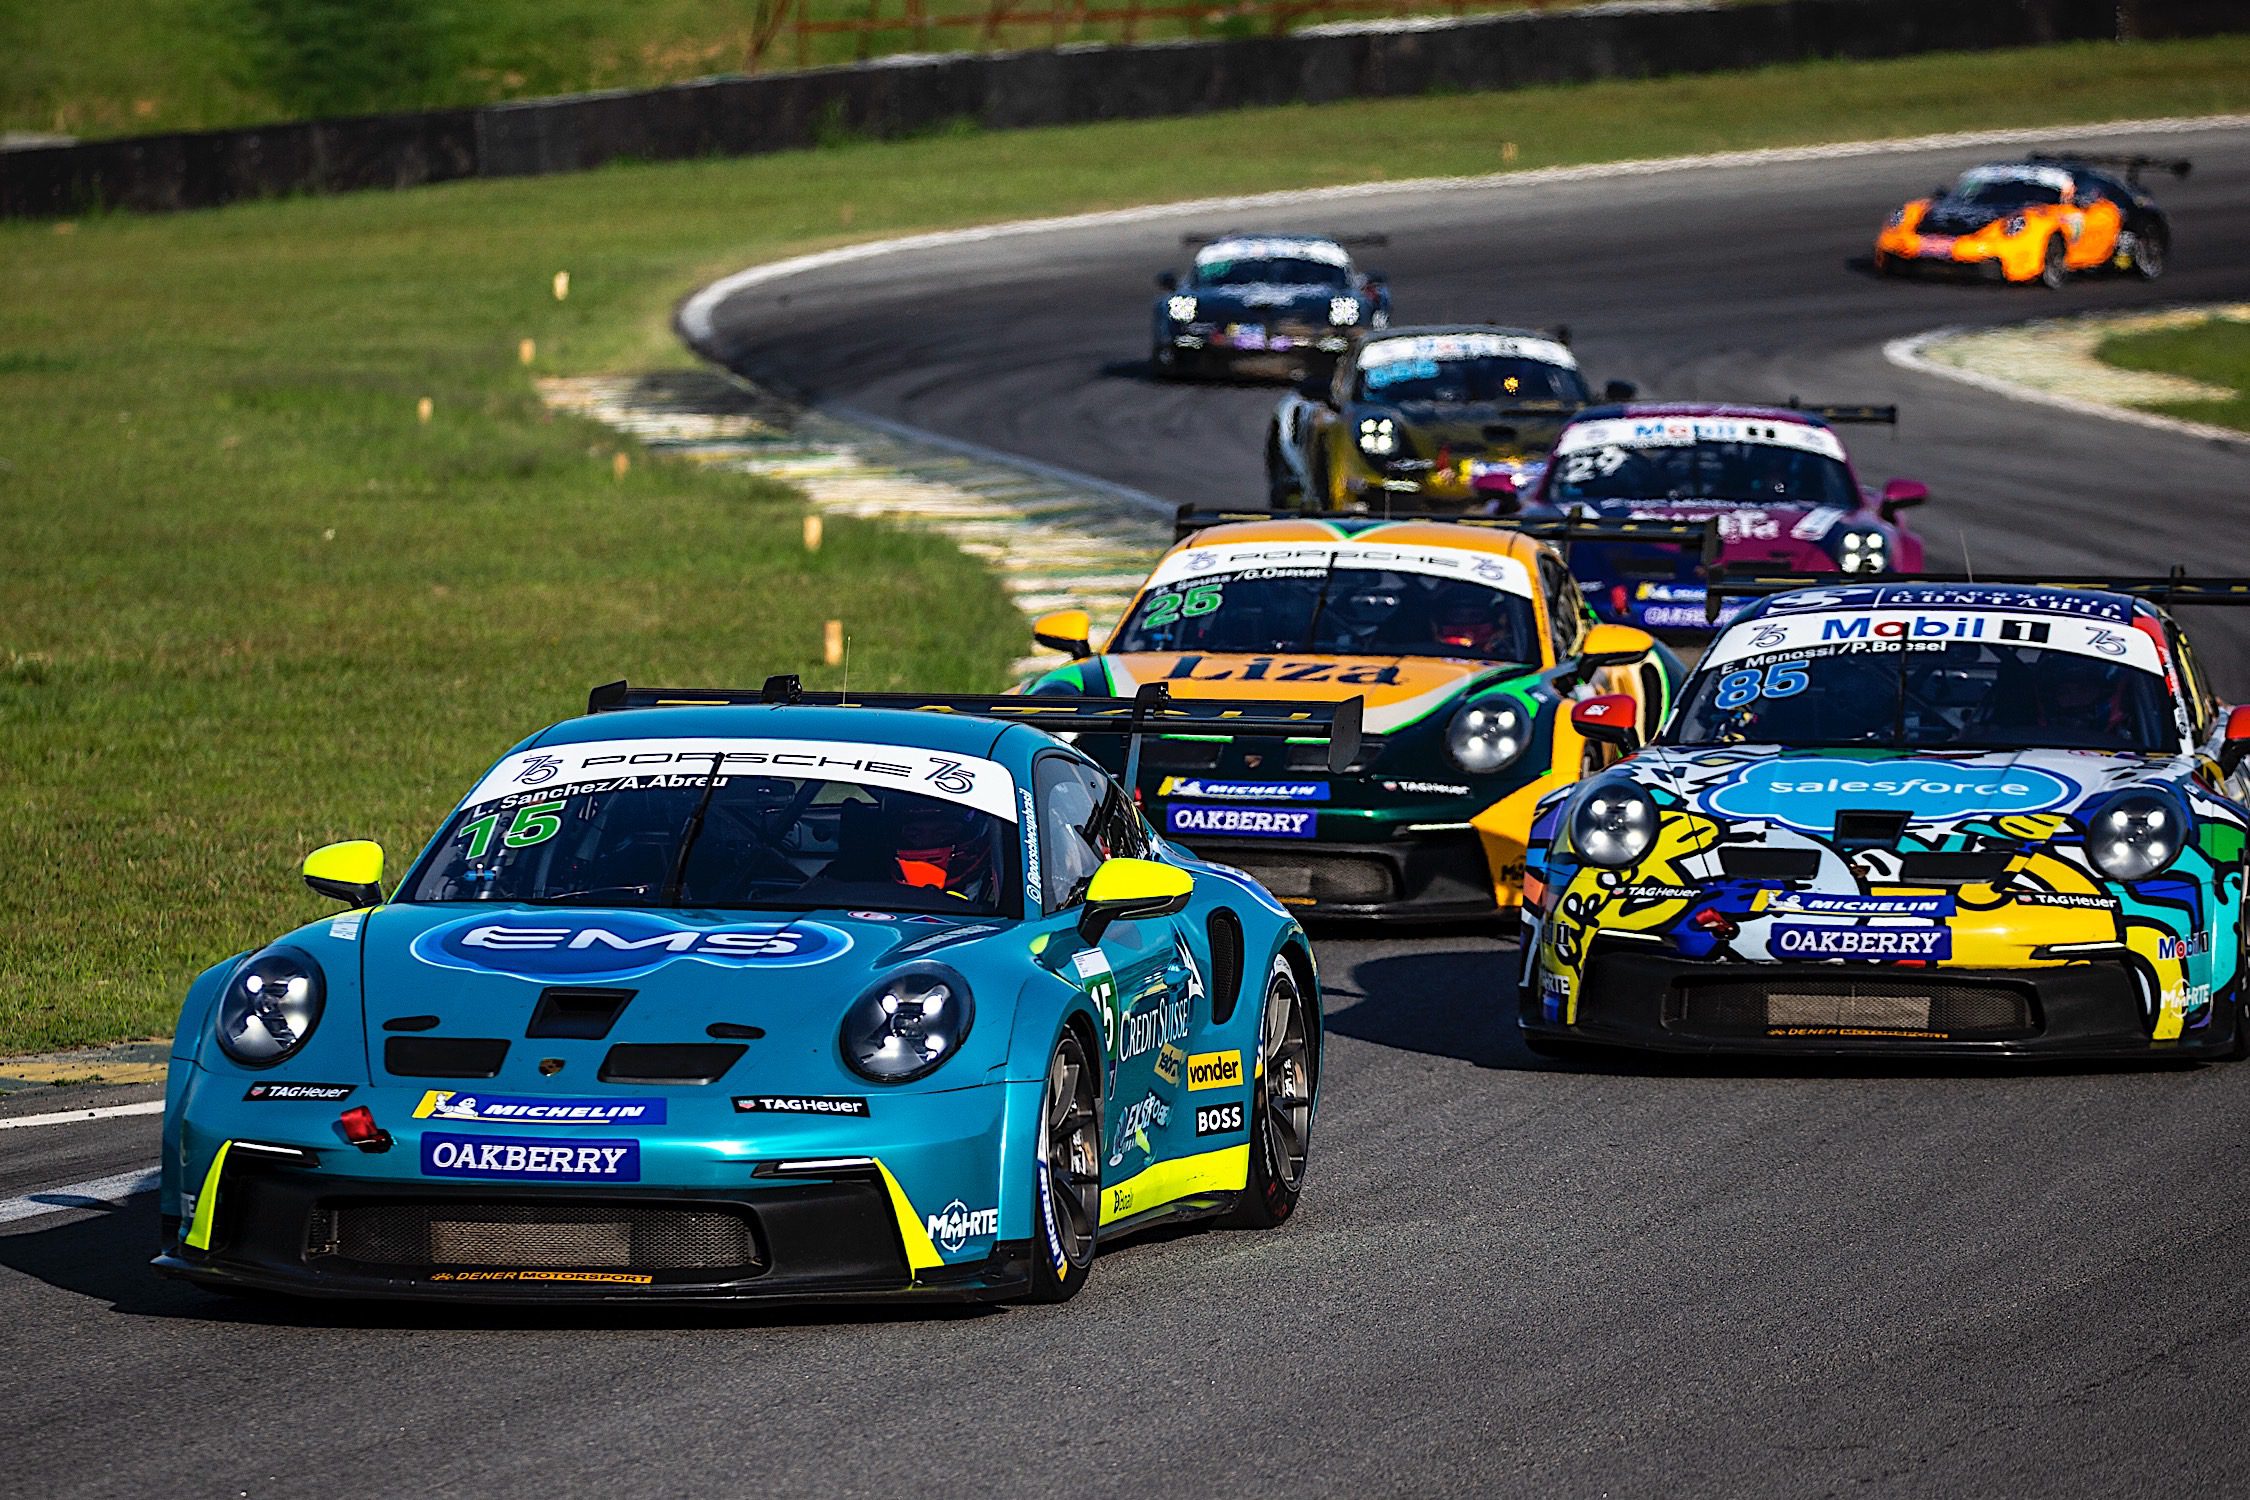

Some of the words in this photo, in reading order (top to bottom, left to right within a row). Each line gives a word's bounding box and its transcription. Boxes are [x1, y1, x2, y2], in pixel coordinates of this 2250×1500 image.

[1564, 446, 1629, 483] 29
[1141, 583, 1224, 631] 25
[1821, 617, 1985, 640] Mobil
[1163, 656, 1407, 686] Liza
[1714, 659, 1810, 710] 85
[512, 755, 563, 785] 75
[581, 752, 913, 778] PORSCHE
[924, 757, 977, 794] 75
[1205, 783, 1317, 796] MICHELIN
[1769, 778, 2030, 797] salesforce
[473, 804, 493, 819] L.
[1174, 809, 1309, 833] OAKBERRY
[458, 799, 568, 861] 15
[1807, 900, 1939, 912] MICHELIN
[460, 925, 803, 955] EMS
[1780, 930, 1941, 954] OAKBERRY
[1190, 1056, 1239, 1084] vonder
[483, 1103, 648, 1118] MICHELIN
[1198, 1106, 1242, 1133] BOSS
[432, 1141, 628, 1175] OAKBERRY
[456, 1272, 518, 1281] DENER
[521, 1272, 649, 1284] MOTORSPORT
